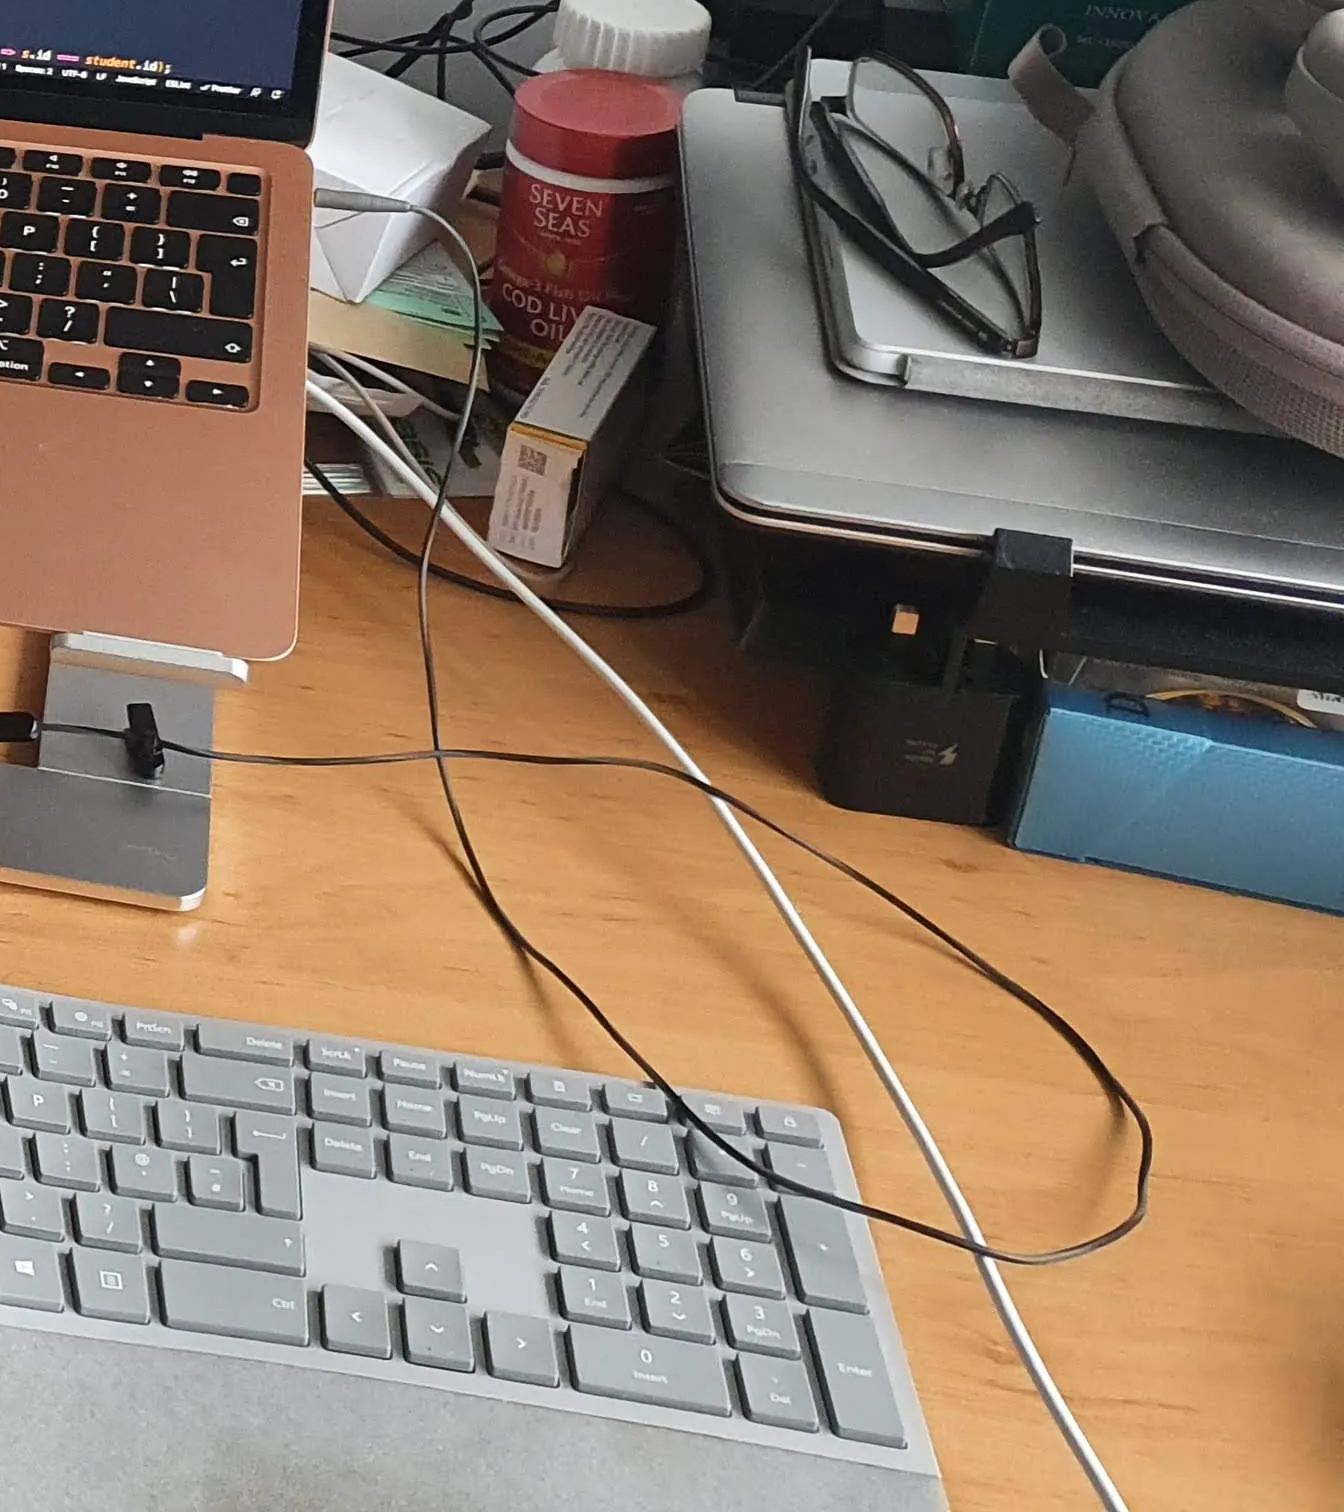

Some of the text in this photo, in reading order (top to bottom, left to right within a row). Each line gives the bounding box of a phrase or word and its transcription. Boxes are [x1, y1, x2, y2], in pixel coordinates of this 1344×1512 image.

[529, 184, 604, 217] SEVEN
[533, 207, 591, 238] SEAS
[502, 284, 543, 314] COD
[136, 1020, 172, 1035] PrtScn
[323, 1088, 357, 1103] Insert
[473, 1110, 508, 1126] PgUp
[549, 1120, 582, 1137] Clear
[324, 1137, 362, 1152] Delete
[479, 1161, 514, 1179] PgDn
[837, 1362, 873, 1377] Enter
